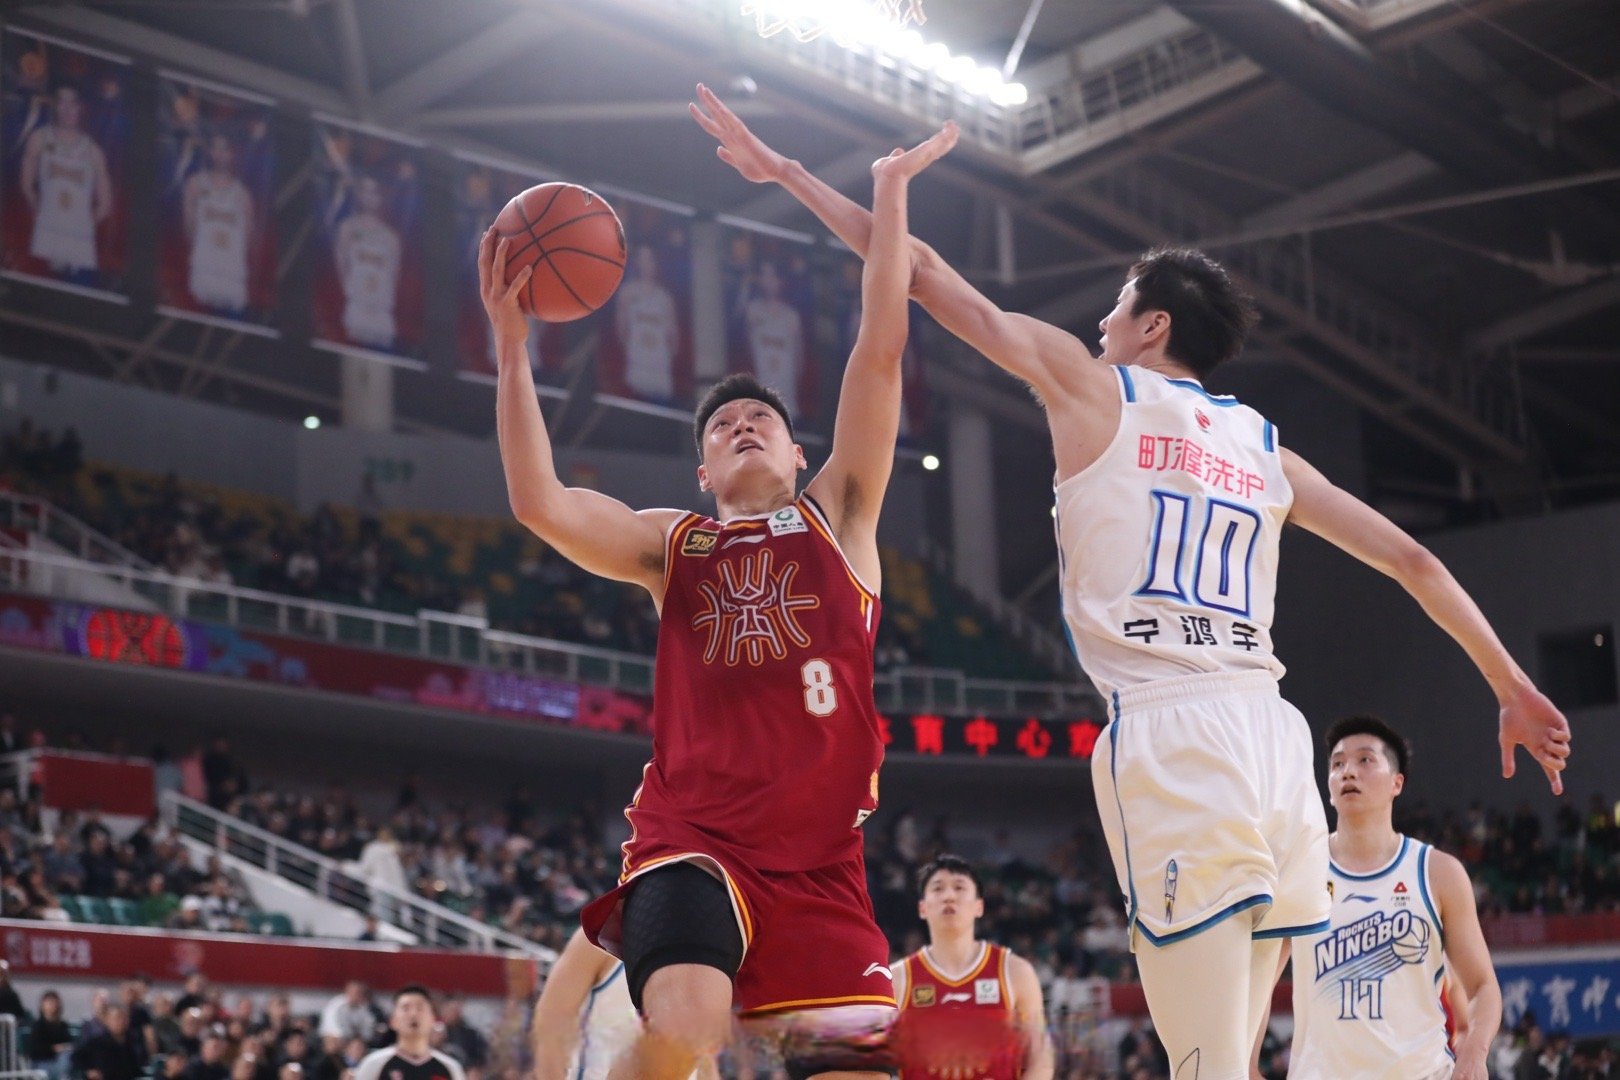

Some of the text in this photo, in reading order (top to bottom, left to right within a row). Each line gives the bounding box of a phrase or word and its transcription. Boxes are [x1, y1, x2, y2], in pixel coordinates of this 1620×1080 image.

[1138, 434, 1265, 499] 町渥洗护
[1131, 489, 1261, 620] 10
[801, 657, 839, 718] 8
[1315, 909, 1411, 981] NINGBO
[1337, 912, 1383, 941] ROCKETS
[1338, 978, 1383, 1020] 17
